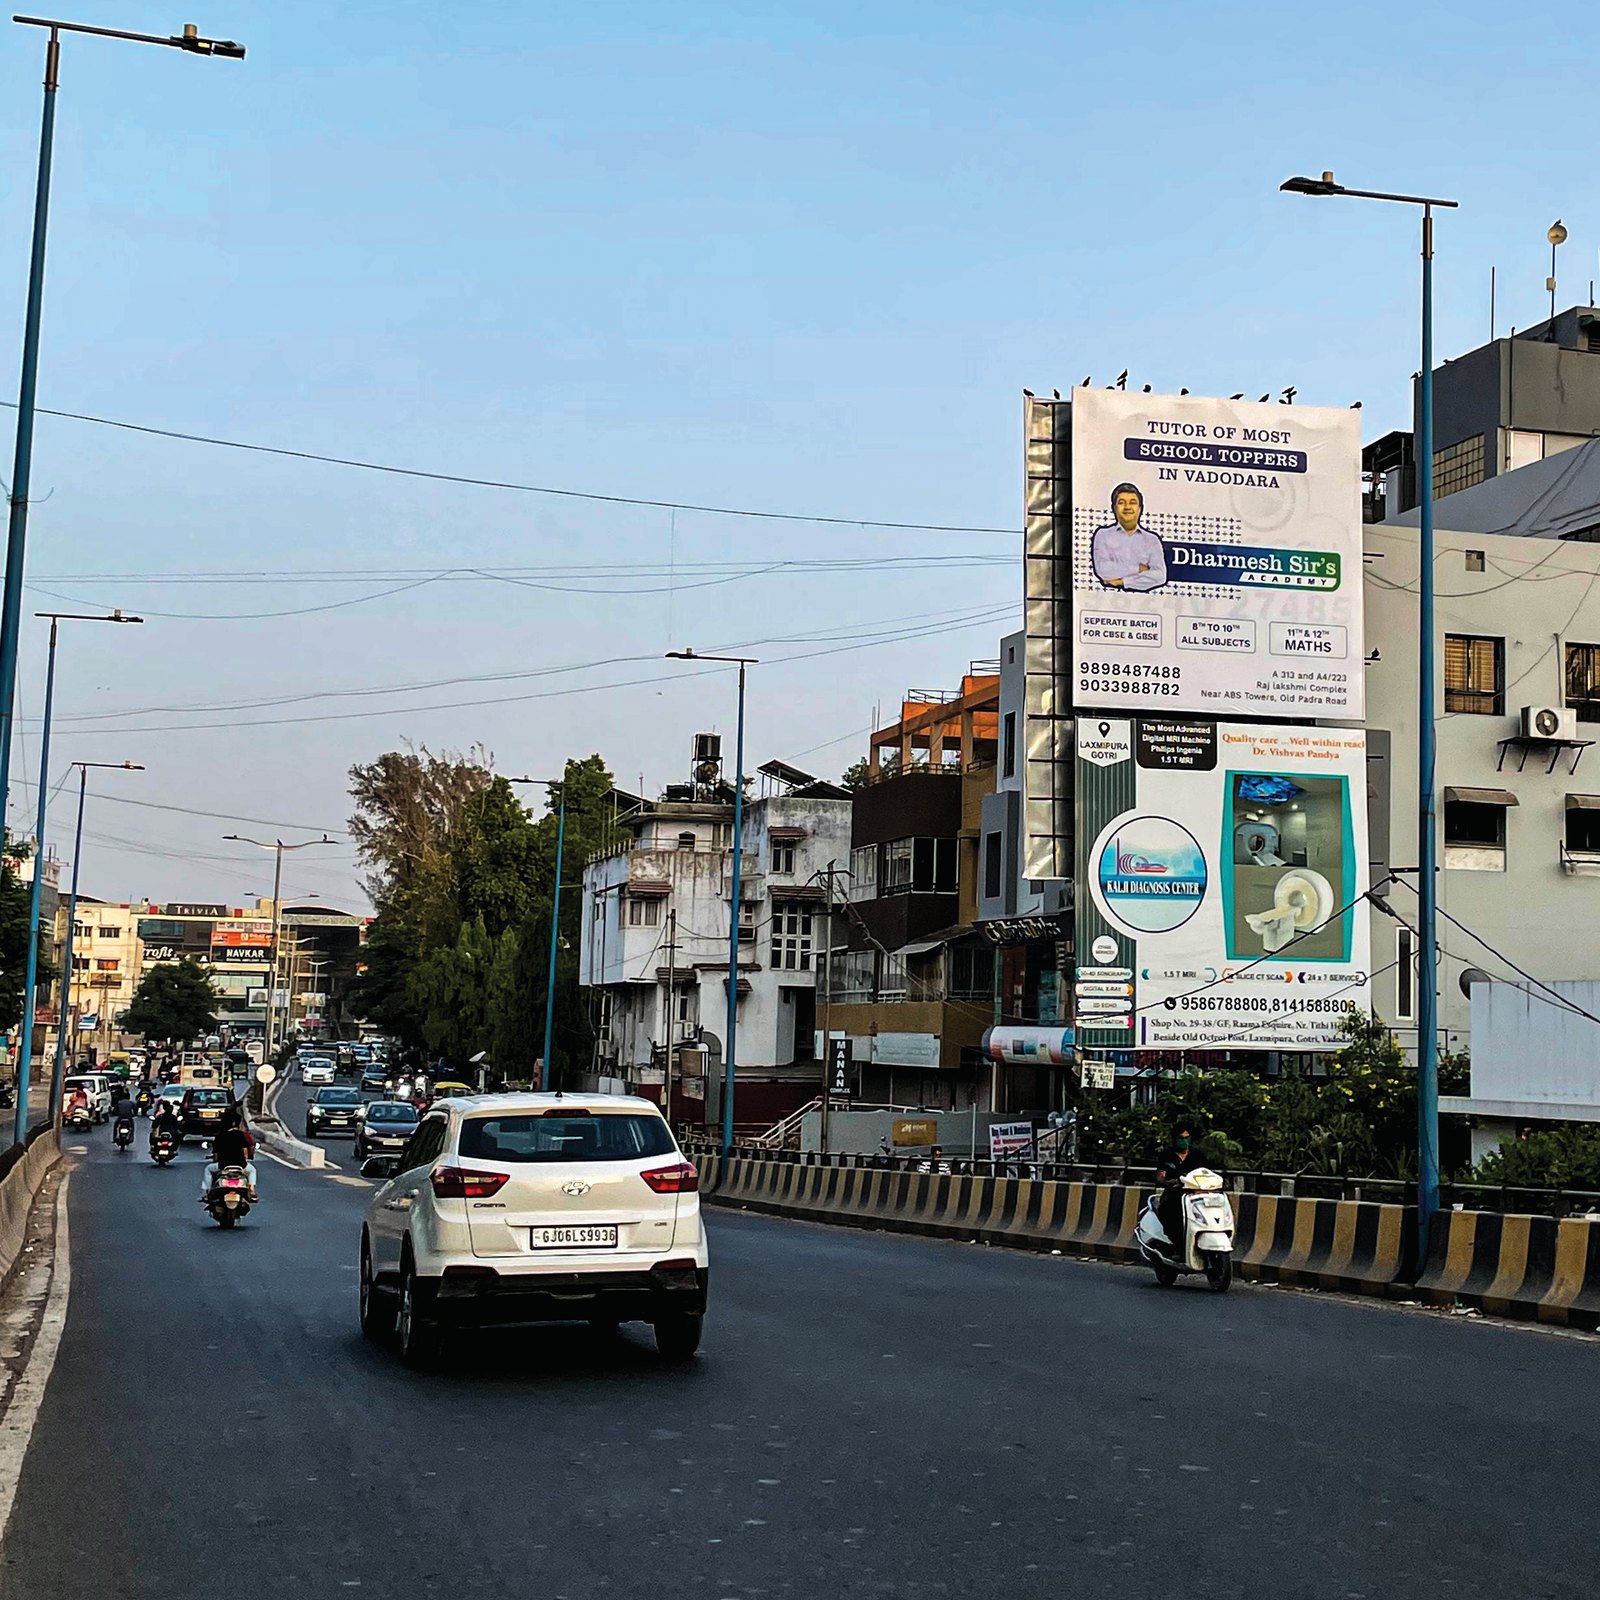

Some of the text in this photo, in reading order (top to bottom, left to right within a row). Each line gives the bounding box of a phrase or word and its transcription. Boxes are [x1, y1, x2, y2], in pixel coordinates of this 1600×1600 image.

[1148, 421, 1291, 444] TUTOR OF MOST
[1140, 443, 1298, 467] SCHOOL TOPPERS
[1159, 468, 1280, 488] IN VADODARA
[1172, 548, 1336, 575] Dharmesh Sir's
[1248, 574, 1327, 586] ACADEMY
[1084, 617, 1157, 628] SEPERATE BATCH
[1207, 624, 1219, 632] TO
[1103, 631, 1125, 639] CBSE
[1182, 636, 1250, 647] ALL SUBJECTS
[1285, 640, 1332, 652] MATHS
[1080, 662, 1181, 679] 9898487488
[1281, 671, 1295, 679] 313
[1298, 672, 1313, 680] and
[1317, 674, 1347, 682] A4/223
[1080, 679, 1180, 696] 9033988782
[1257, 681, 1270, 690] Raj
[1310, 684, 1347, 694] Complex
[1201, 690, 1221, 698] Near
[1224, 691, 1241, 699] ABS
[1280, 694, 1295, 702] Old
[1298, 695, 1322, 704] Padra
[1326, 697, 1347, 705] Road
[1157, 724, 1174, 732] Most
[1176, 726, 1210, 734] Advanced
[1142, 734, 1211, 744] Digital MRI Machine
[1222, 733, 1257, 746] Quality
[1312, 739, 1340, 747] within
[1080, 741, 1128, 750] LAXMIPURA
[1091, 751, 1117, 759] GOTRI
[1253, 747, 1339, 760] Dr. Vishvas Pandya
[1130, 881, 1170, 894] DIAGNOSIS
[1172, 882, 1199, 895] CENTER
[176, 905, 219, 915] TRIVIA
[143, 947, 173, 958] rofit
[226, 949, 264, 958] NAVKAR
[1181, 997, 1355, 1013] 9586788808,8141588808
[1151, 1019, 1171, 1029] Shop
[1153, 1033, 1180, 1041] Beside
[1182, 1033, 1197, 1041] Old
[1249, 1034, 1294, 1044] Laxmipura,
[836, 1041, 846, 1087] MANAN
[542, 1229, 615, 1243] GJ06LS9936
